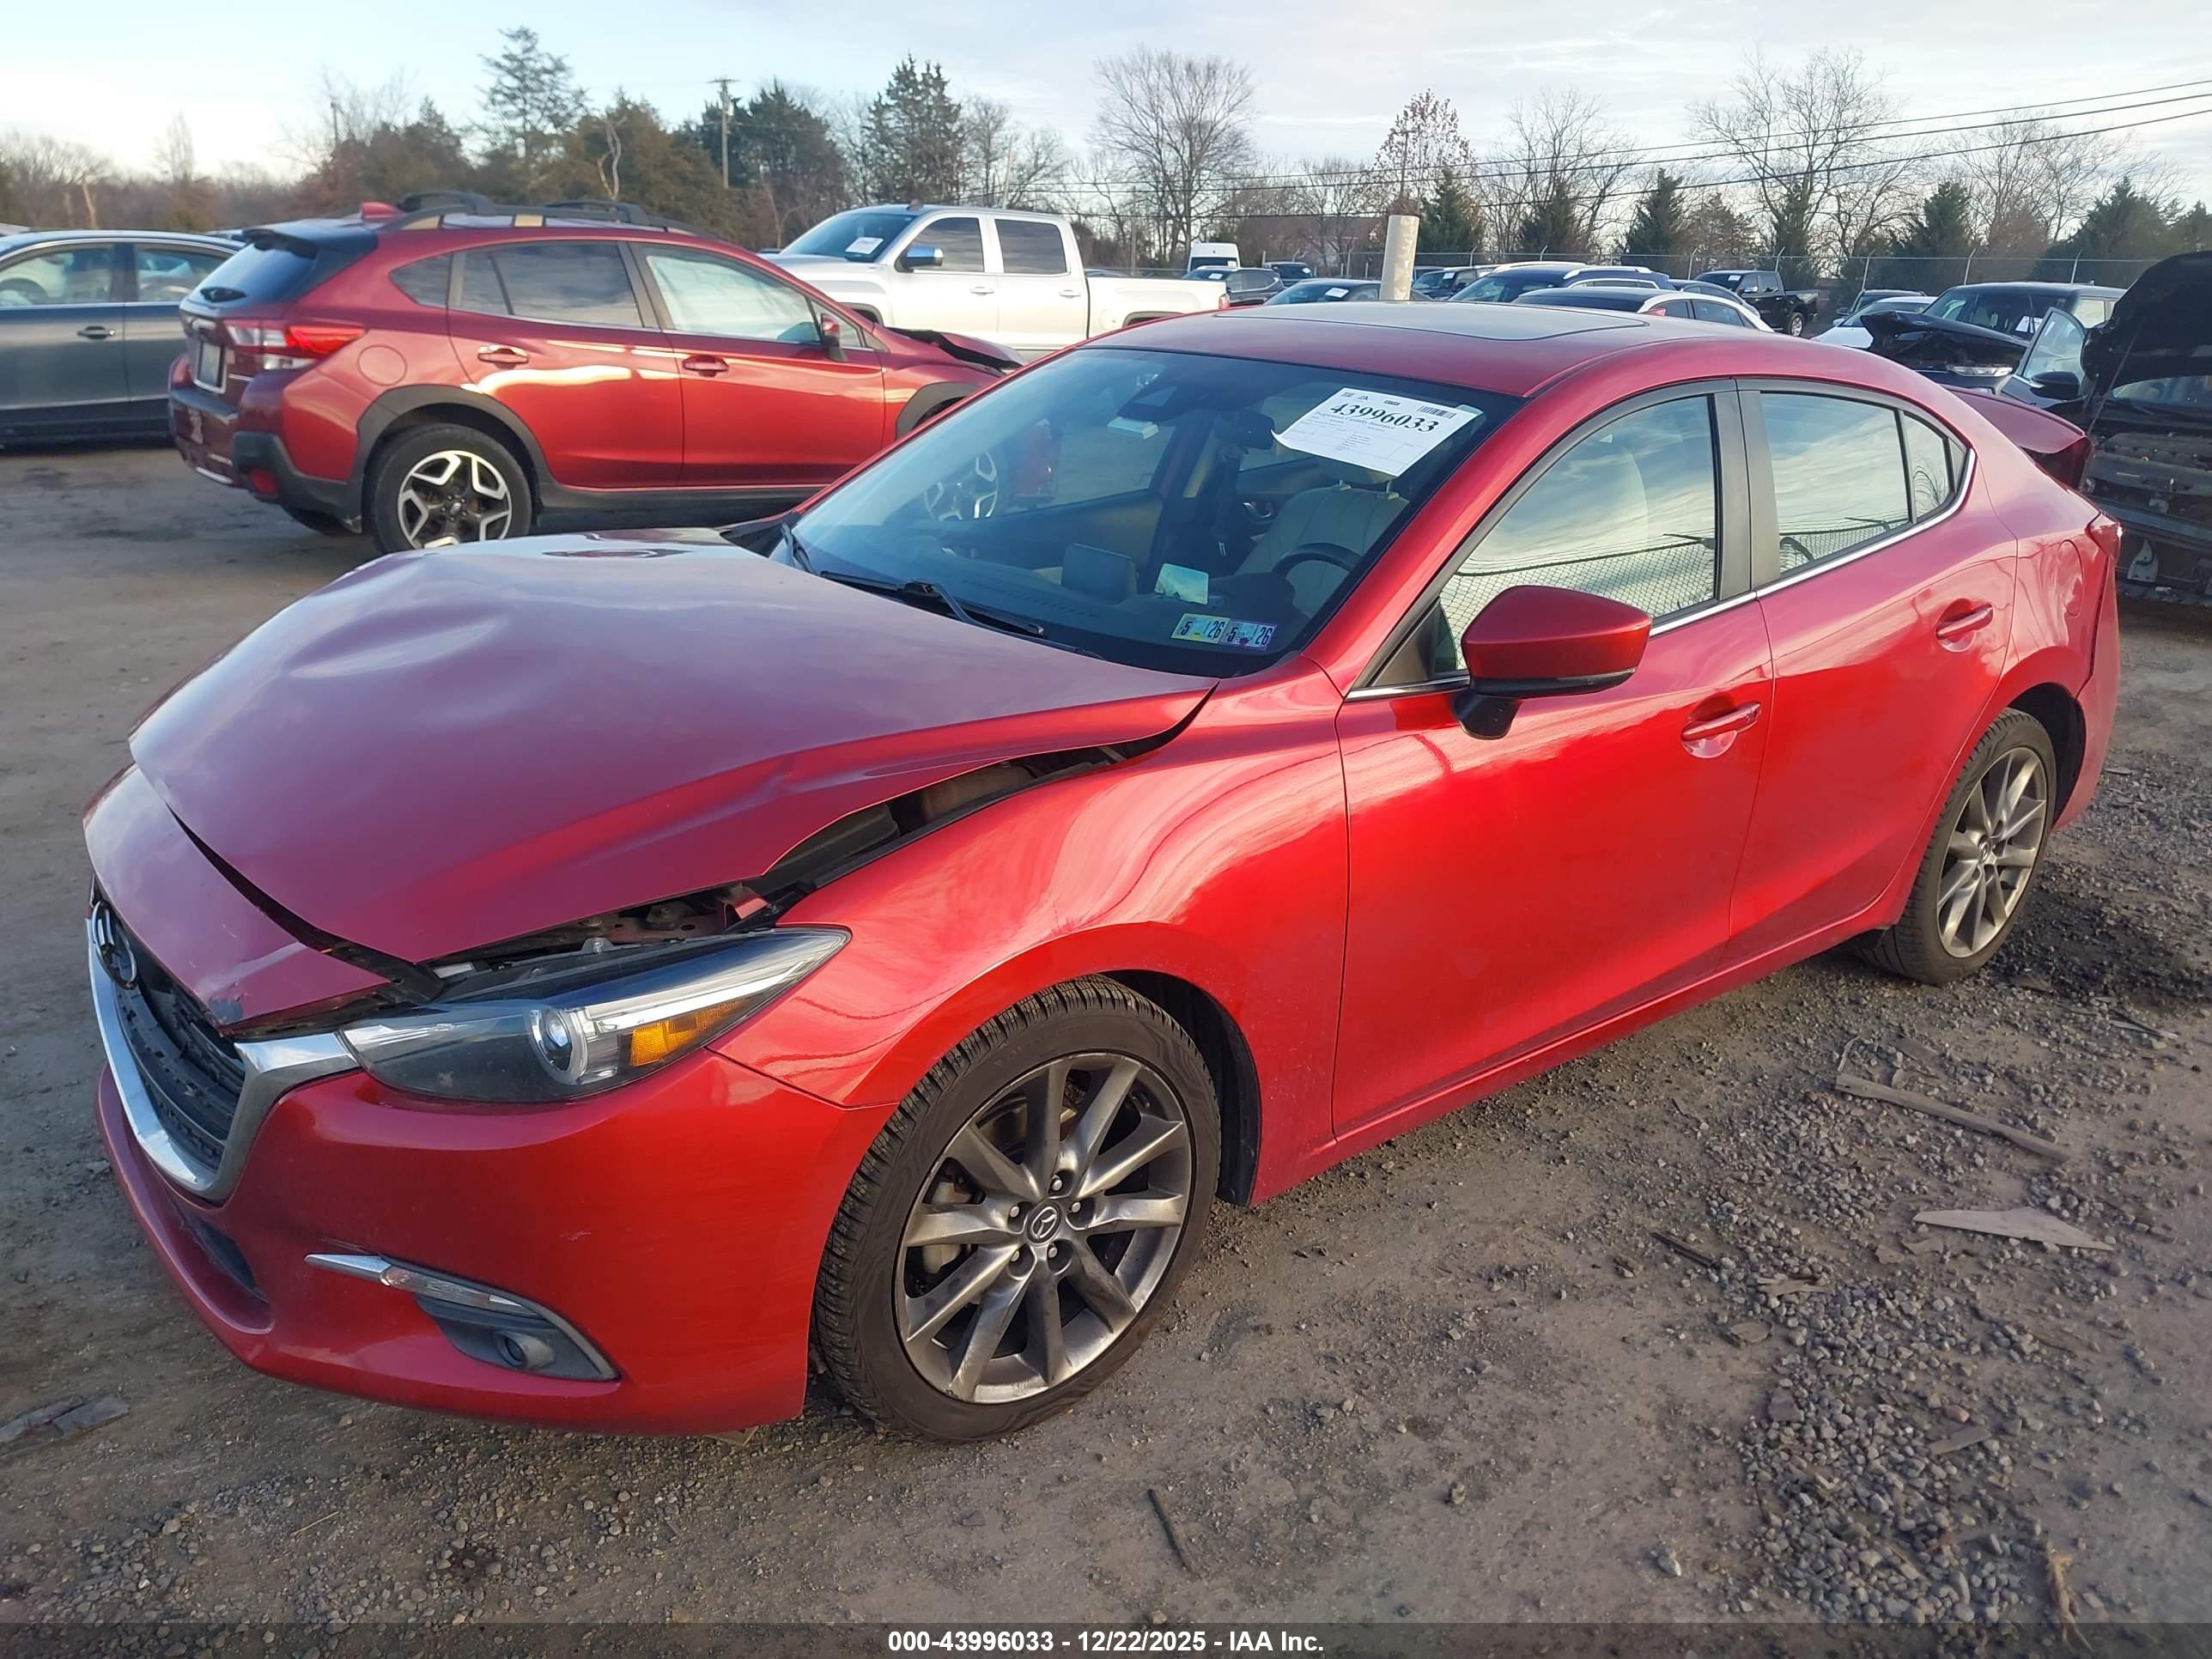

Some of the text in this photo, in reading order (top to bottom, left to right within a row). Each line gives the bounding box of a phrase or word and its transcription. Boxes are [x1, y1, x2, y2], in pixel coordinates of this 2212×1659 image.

[1331, 403, 1439, 432] 43996033
[1181, 621, 1225, 638] 5 26
[1227, 627, 1272, 645] 5 26
